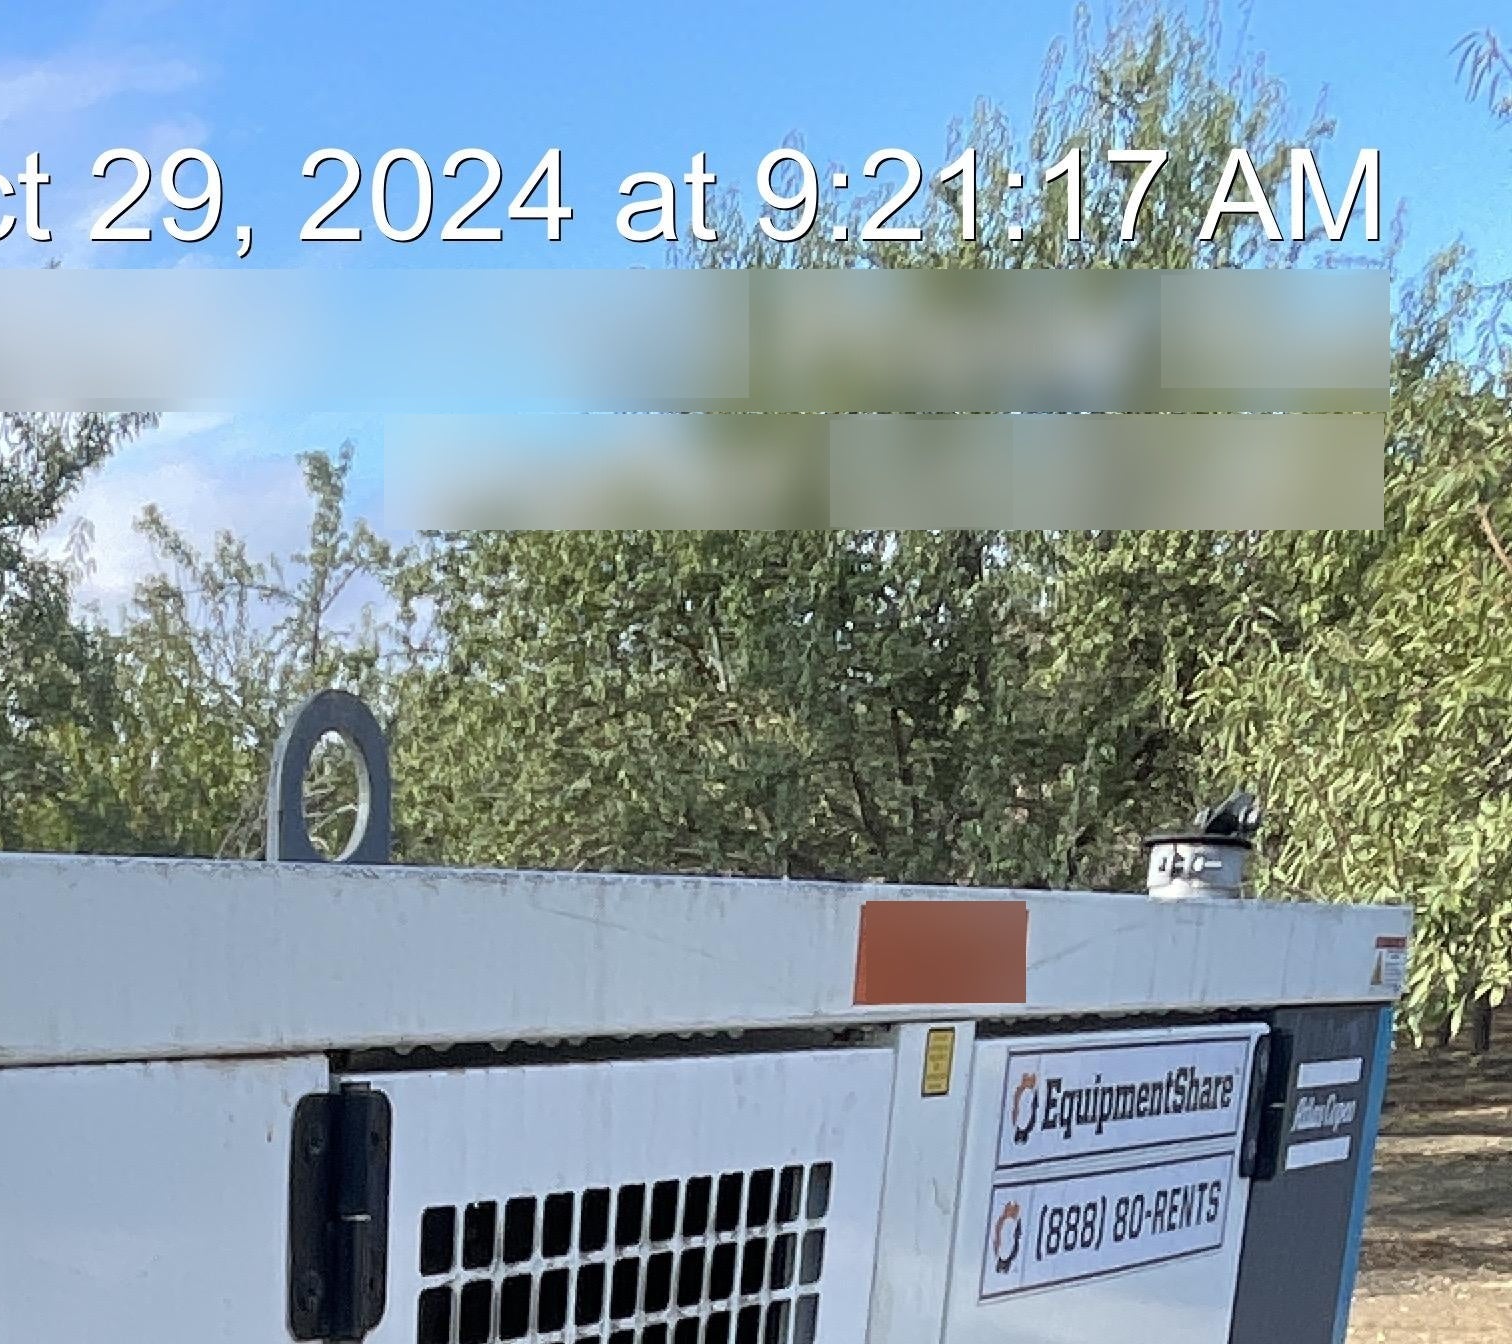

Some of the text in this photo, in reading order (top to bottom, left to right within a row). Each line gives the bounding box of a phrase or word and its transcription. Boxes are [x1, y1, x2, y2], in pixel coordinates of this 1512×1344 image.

[1041, 1065, 1234, 1139] EquipmentShare
[1036, 1180, 1222, 1261] (888) 80-RENTS
